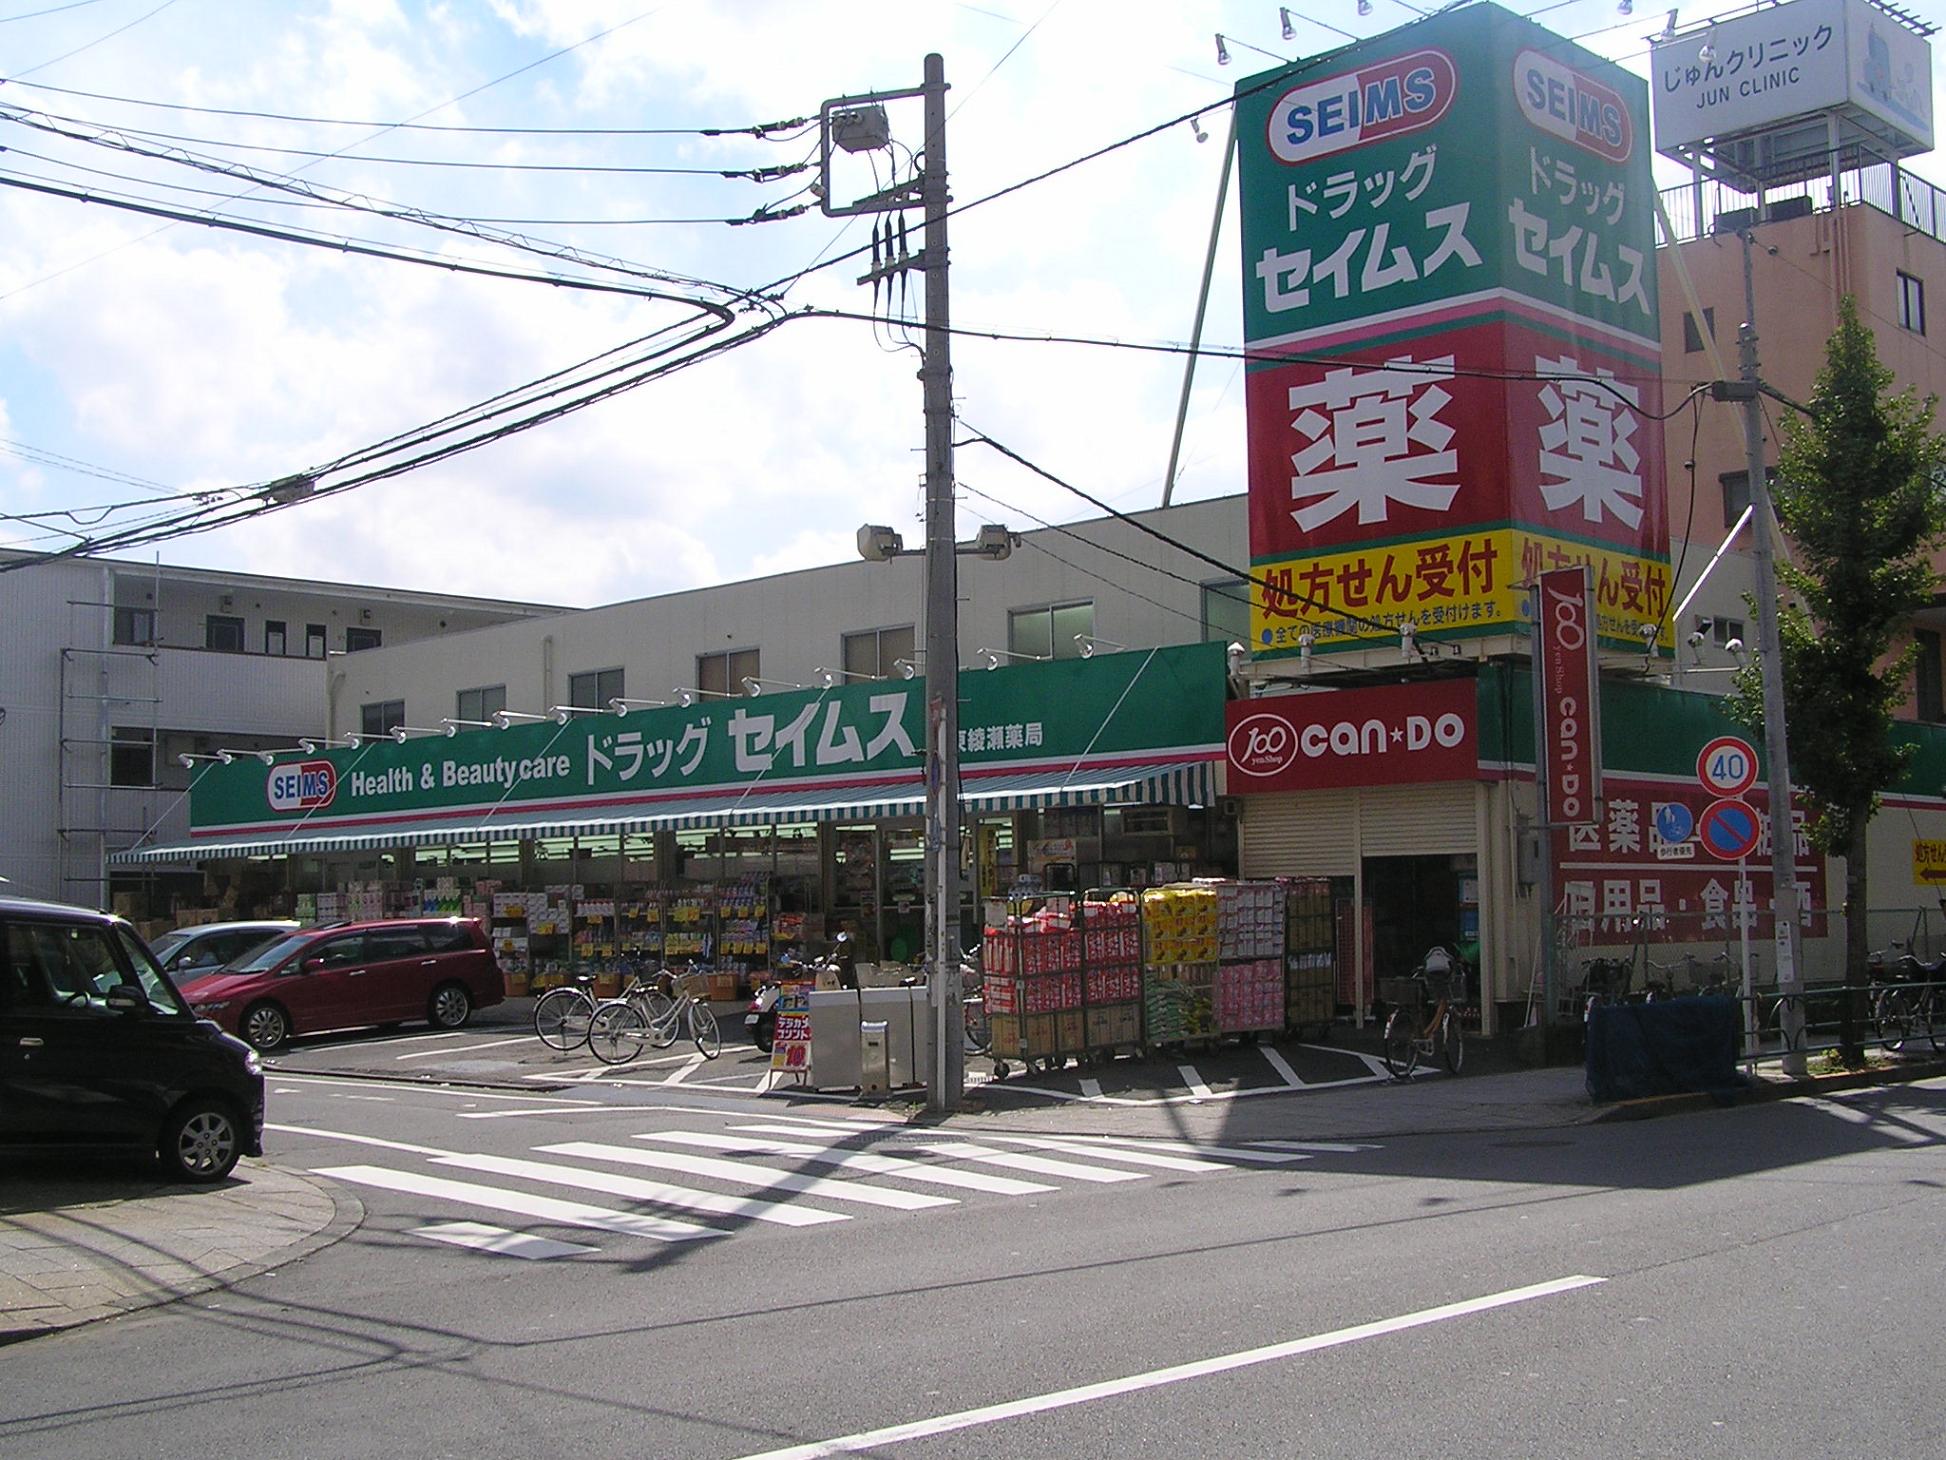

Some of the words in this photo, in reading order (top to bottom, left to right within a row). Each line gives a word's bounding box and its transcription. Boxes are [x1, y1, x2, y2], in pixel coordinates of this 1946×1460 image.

[1664, 24, 1832, 93] じゅんクリニック
[1696, 86, 1730, 109] JUN
[1739, 66, 1800, 97] CLINIC
[1286, 67, 1437, 145] SEIMS
[1527, 68, 1622, 147] SEIMS
[1287, 143, 1438, 232] ドラッグ
[1529, 145, 1624, 226] ドラッグ
[1255, 201, 1484, 314] セイムス
[1508, 197, 1651, 316] セイムス
[1288, 354, 1461, 533] 薬
[1535, 354, 1643, 531] 薬
[1261, 538, 1498, 619] 処方せん受付
[587, 716, 711, 786] ドラッグ
[728, 692, 916, 772] セイムス
[1711, 754, 1744, 780] 40
[274, 769, 330, 800] SEIMS
[351, 766, 413, 797] Health
[420, 763, 436, 790] &
